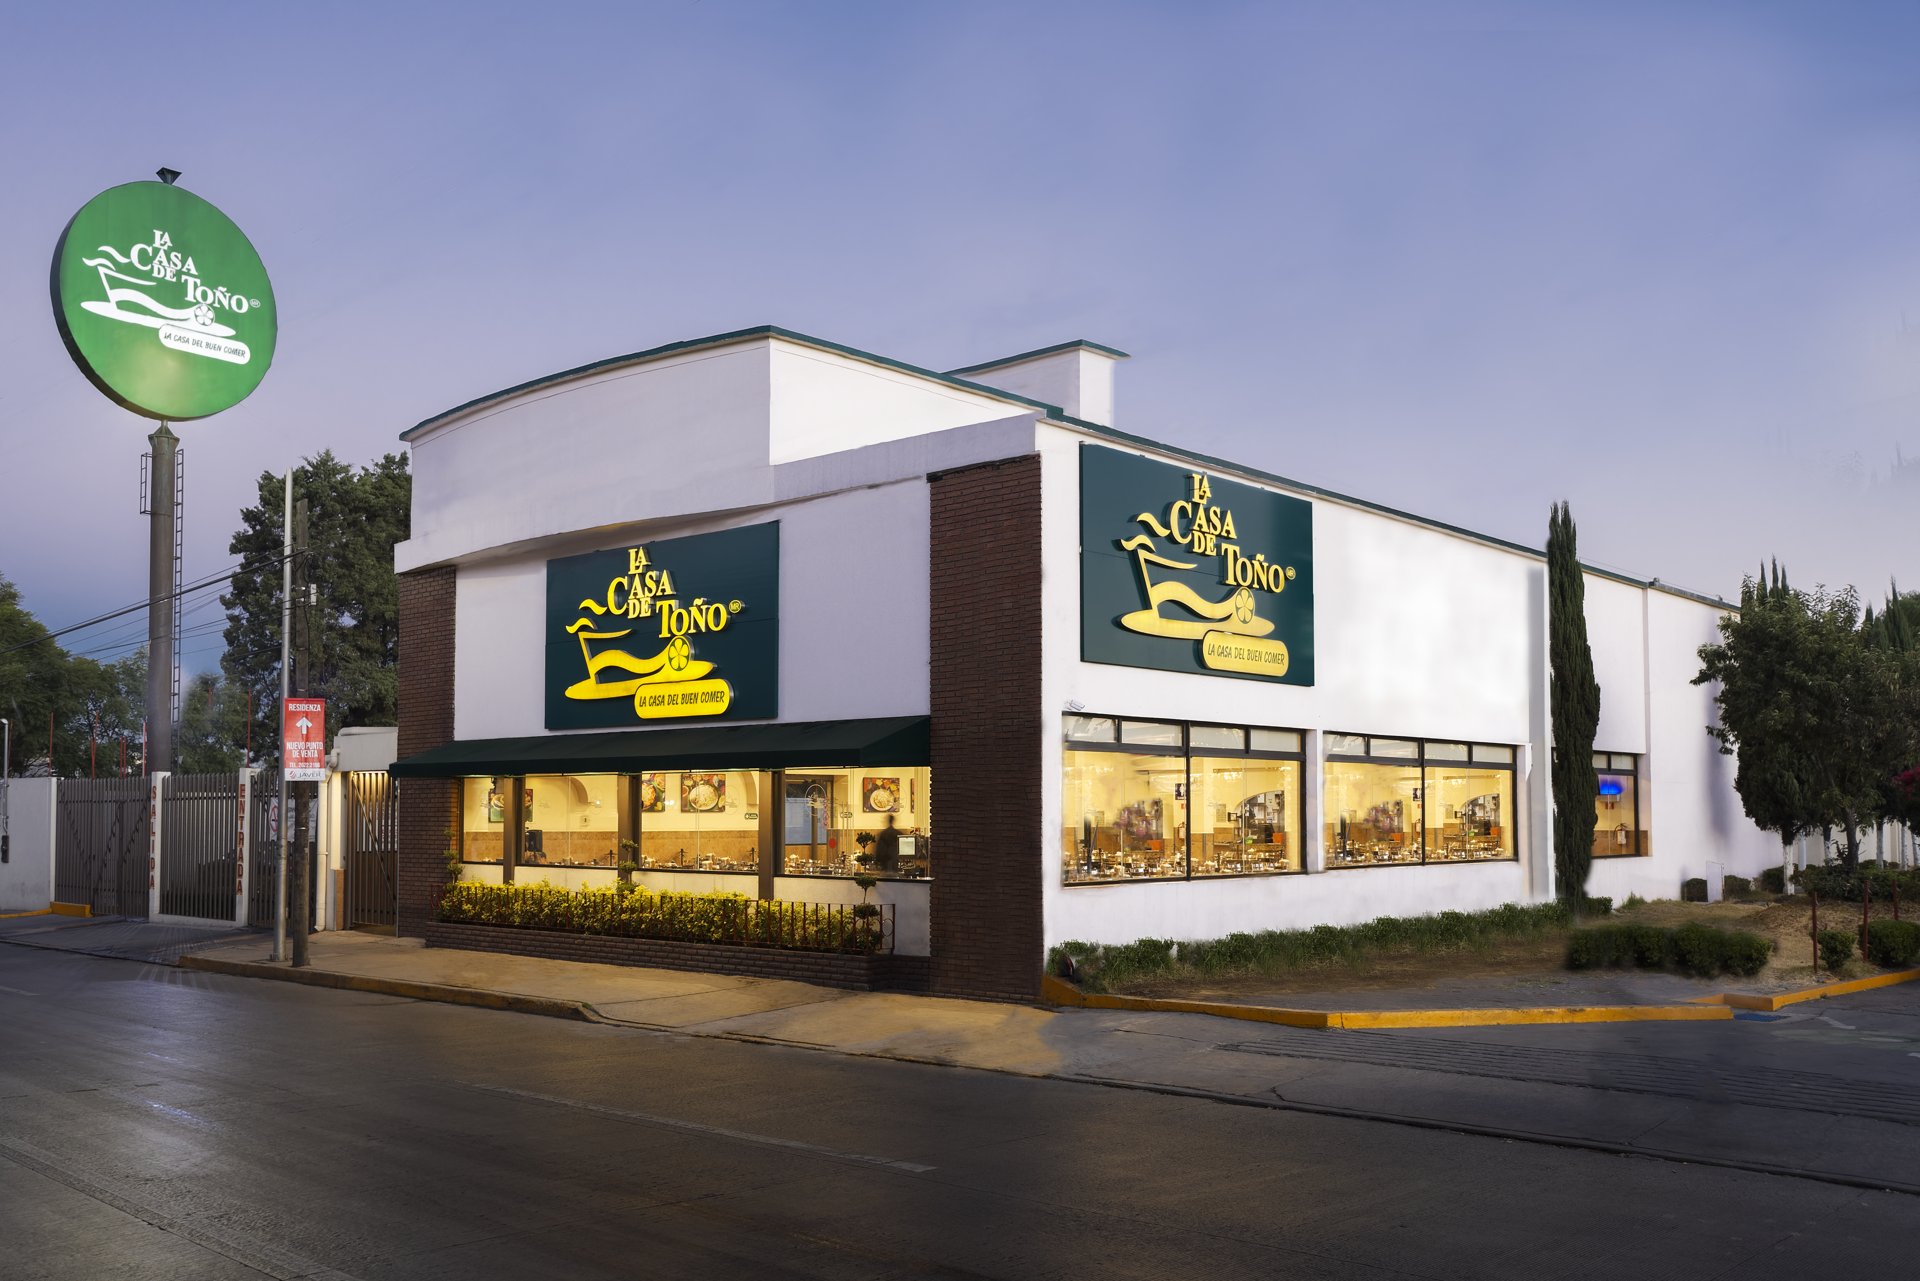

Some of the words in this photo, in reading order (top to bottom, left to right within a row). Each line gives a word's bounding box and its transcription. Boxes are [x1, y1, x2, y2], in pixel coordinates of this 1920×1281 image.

[153, 229, 172, 250] LA
[130, 243, 198, 275] CASA
[152, 263, 176, 282] DE
[181, 274, 248, 313] TOÑO
[163, 332, 172, 340] LA
[173, 334, 190, 344] CASA
[192, 338, 203, 348] DEL
[205, 341, 222, 352] BUEN
[223, 346, 246, 358] COMER
[1192, 473, 1211, 505] LA
[1170, 500, 1237, 544] CASA
[628, 546, 649, 575] LA
[1192, 530, 1217, 556] DE
[1221, 543, 1285, 593] TOÑO
[607, 569, 675, 615] CASA
[627, 597, 653, 619] DE
[656, 597, 728, 638] TOÑO
[1208, 643, 1216, 656] LA
[1216, 644, 1232, 659] CASA
[1234, 647, 1245, 661] DEL
[1247, 649, 1262, 663] BUEN
[1264, 651, 1285, 666] COMER
[288, 703, 321, 712] RESIDENZA
[639, 695, 647, 707] LA
[648, 694, 665, 707] CASA
[667, 693, 679, 706] DEL
[681, 691, 698, 705] BUEN
[700, 688, 725, 704] COMER
[287, 742, 305, 750] NUEVO
[306, 742, 323, 750] PUNTO
[293, 750, 300, 758] DE
[301, 750, 318, 758] VENTA
[237, 784, 245, 895] ENTRADA
